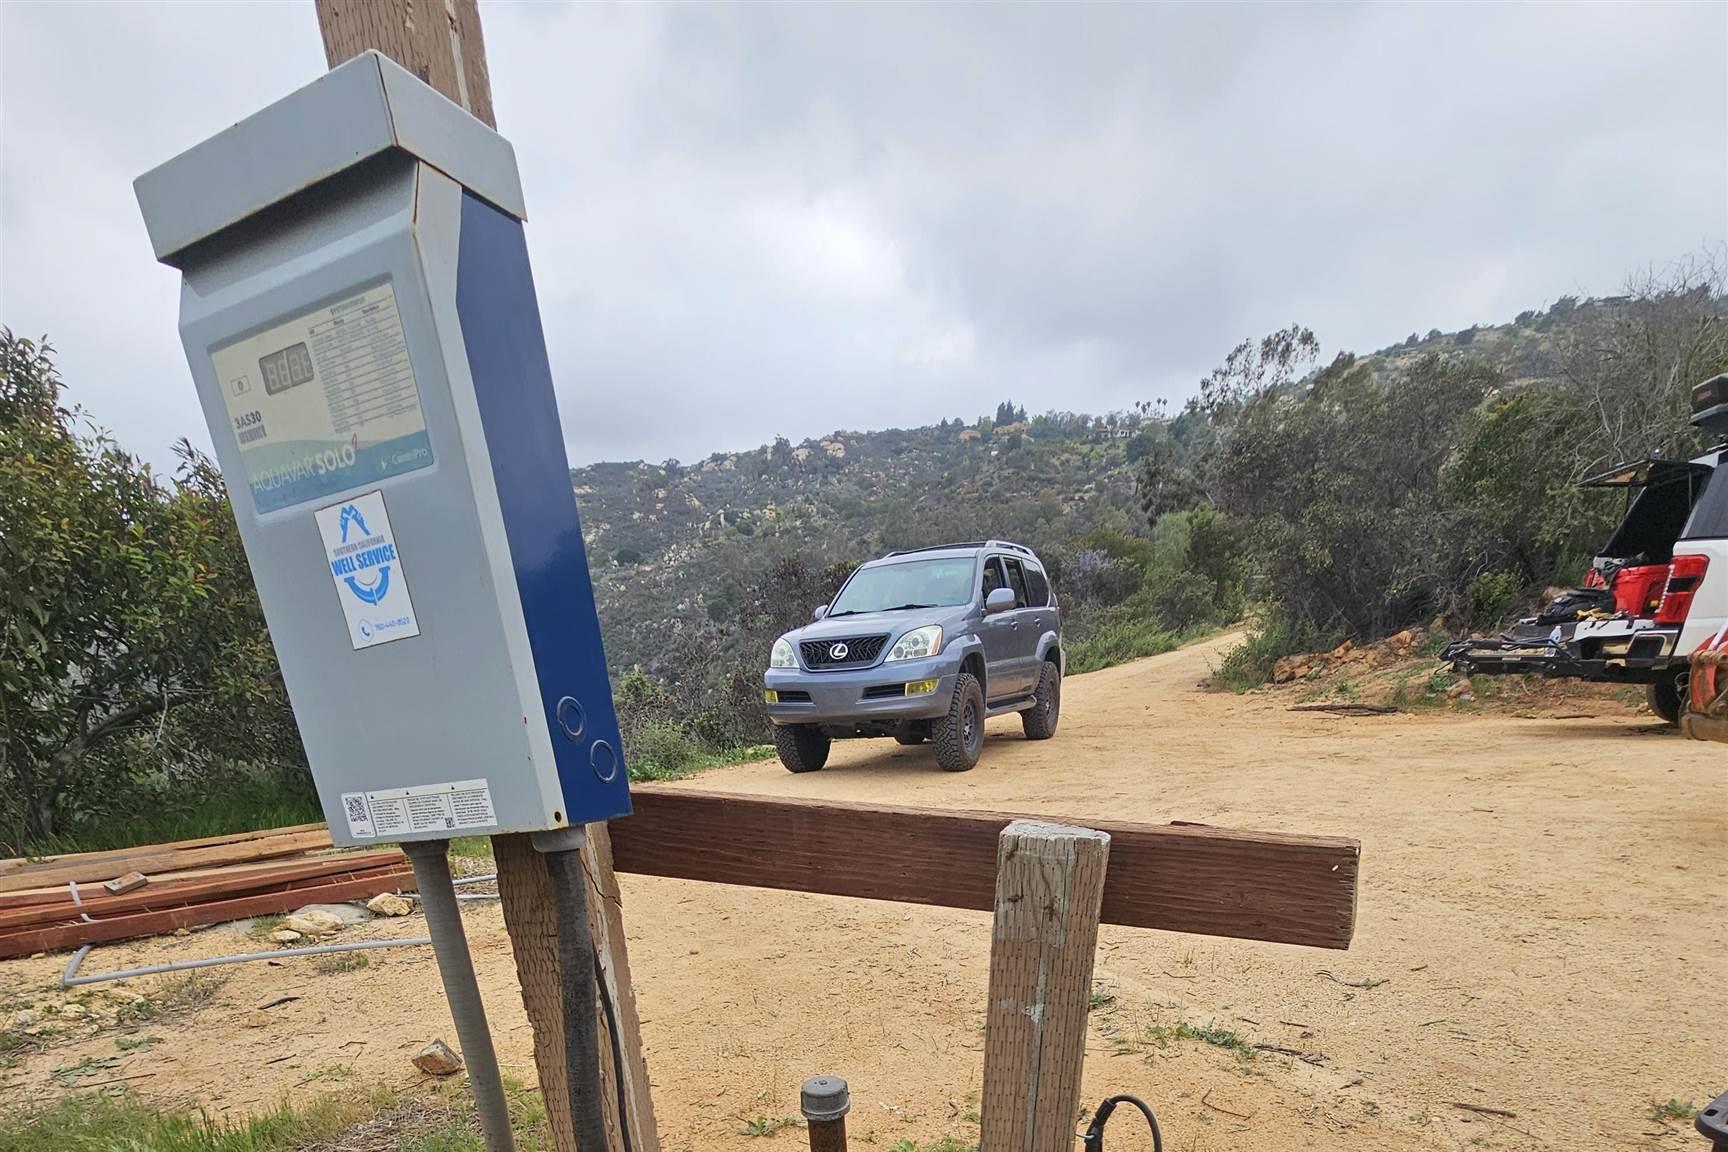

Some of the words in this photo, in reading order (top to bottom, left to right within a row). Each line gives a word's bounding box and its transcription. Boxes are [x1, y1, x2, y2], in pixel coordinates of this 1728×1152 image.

[234, 410, 262, 430] 3AS30
[252, 458, 315, 494] AQUAVAR
[317, 444, 357, 475] SOLO
[331, 556, 357, 577] WELL
[356, 543, 396, 570] SERVICE
